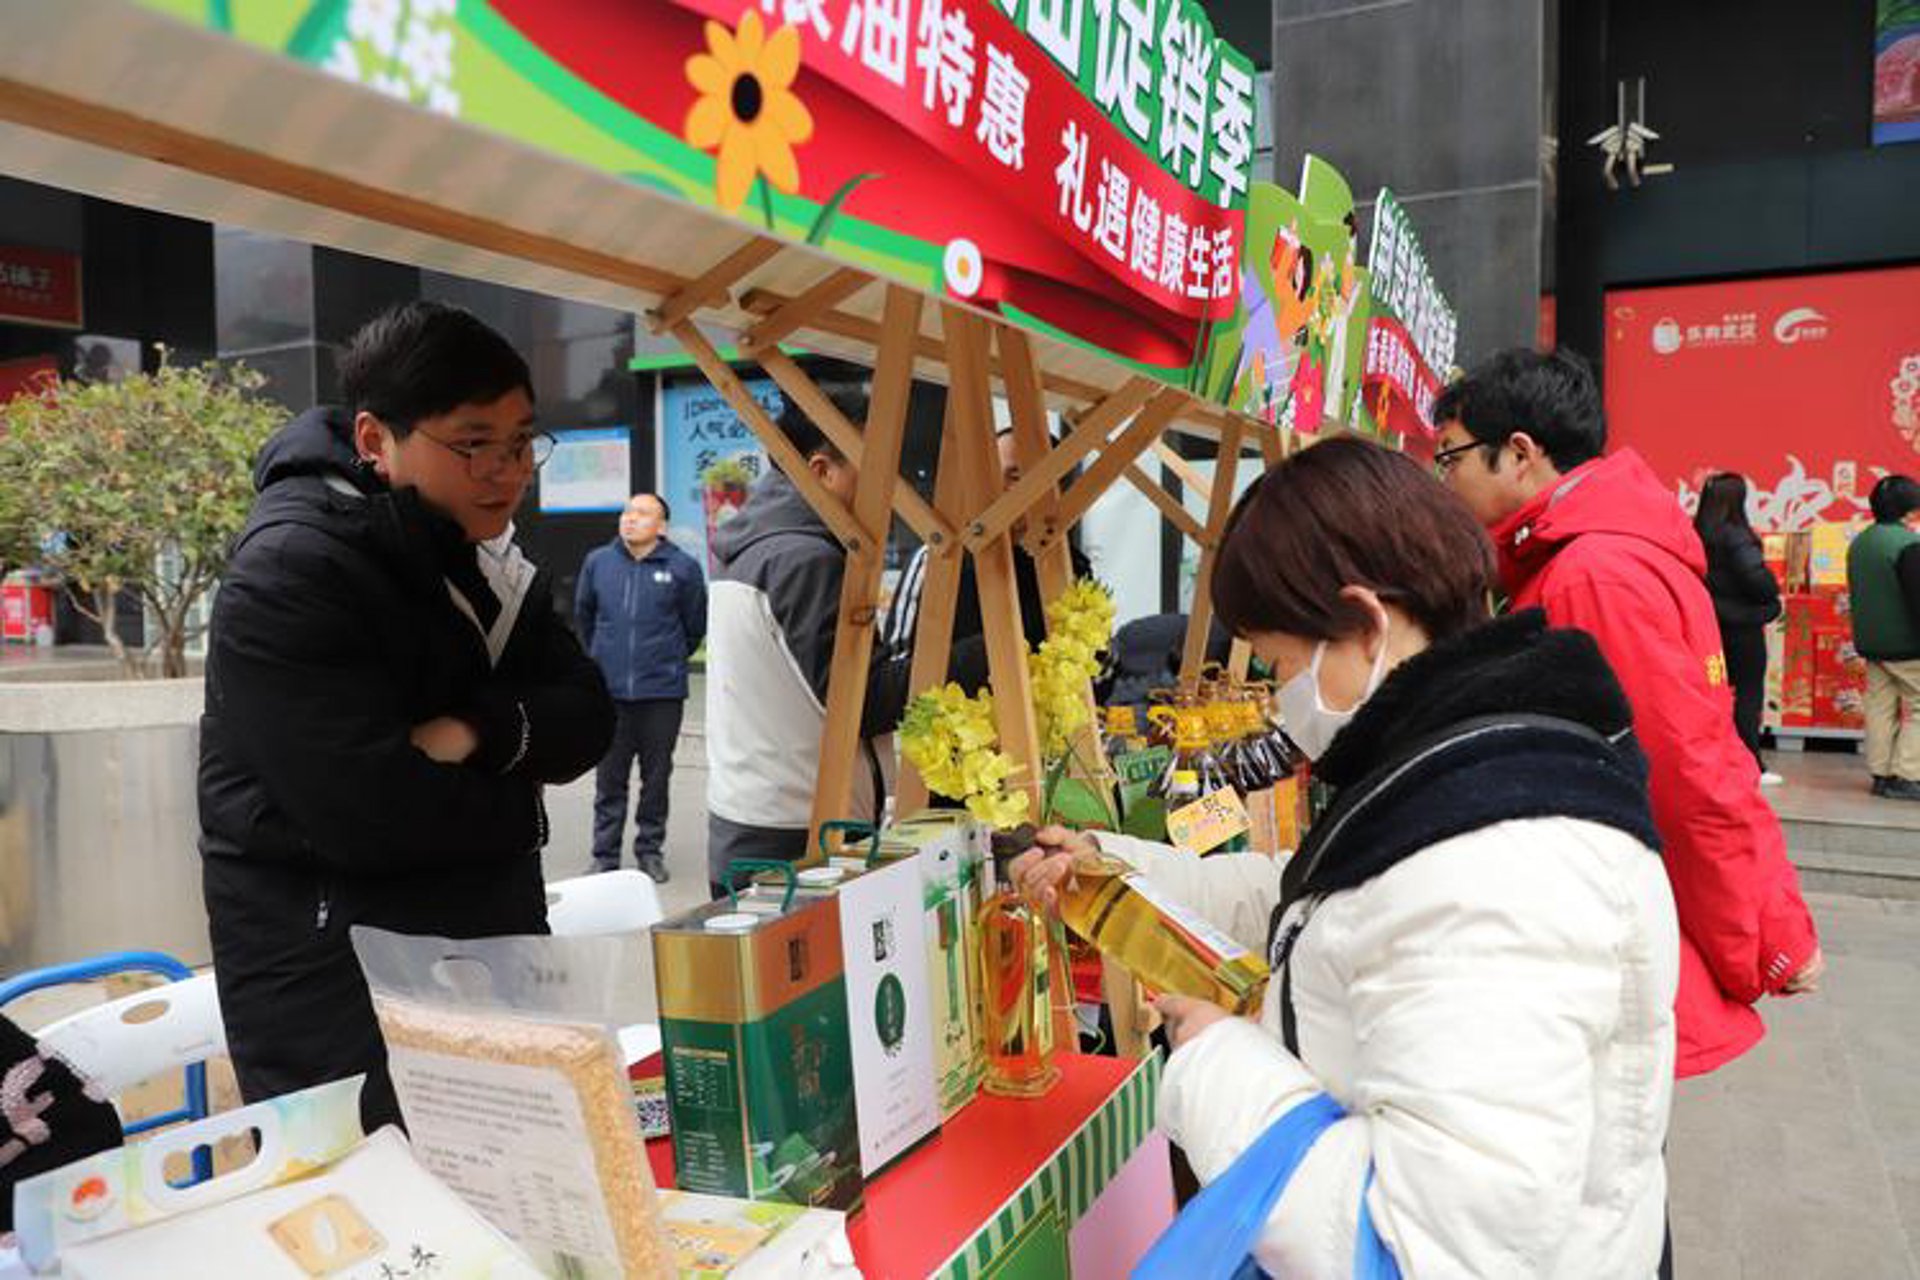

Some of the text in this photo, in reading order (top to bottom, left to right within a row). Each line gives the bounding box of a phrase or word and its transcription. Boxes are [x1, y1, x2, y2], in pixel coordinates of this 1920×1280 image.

[1054, 120, 1234, 299] 礼遇健康生活
